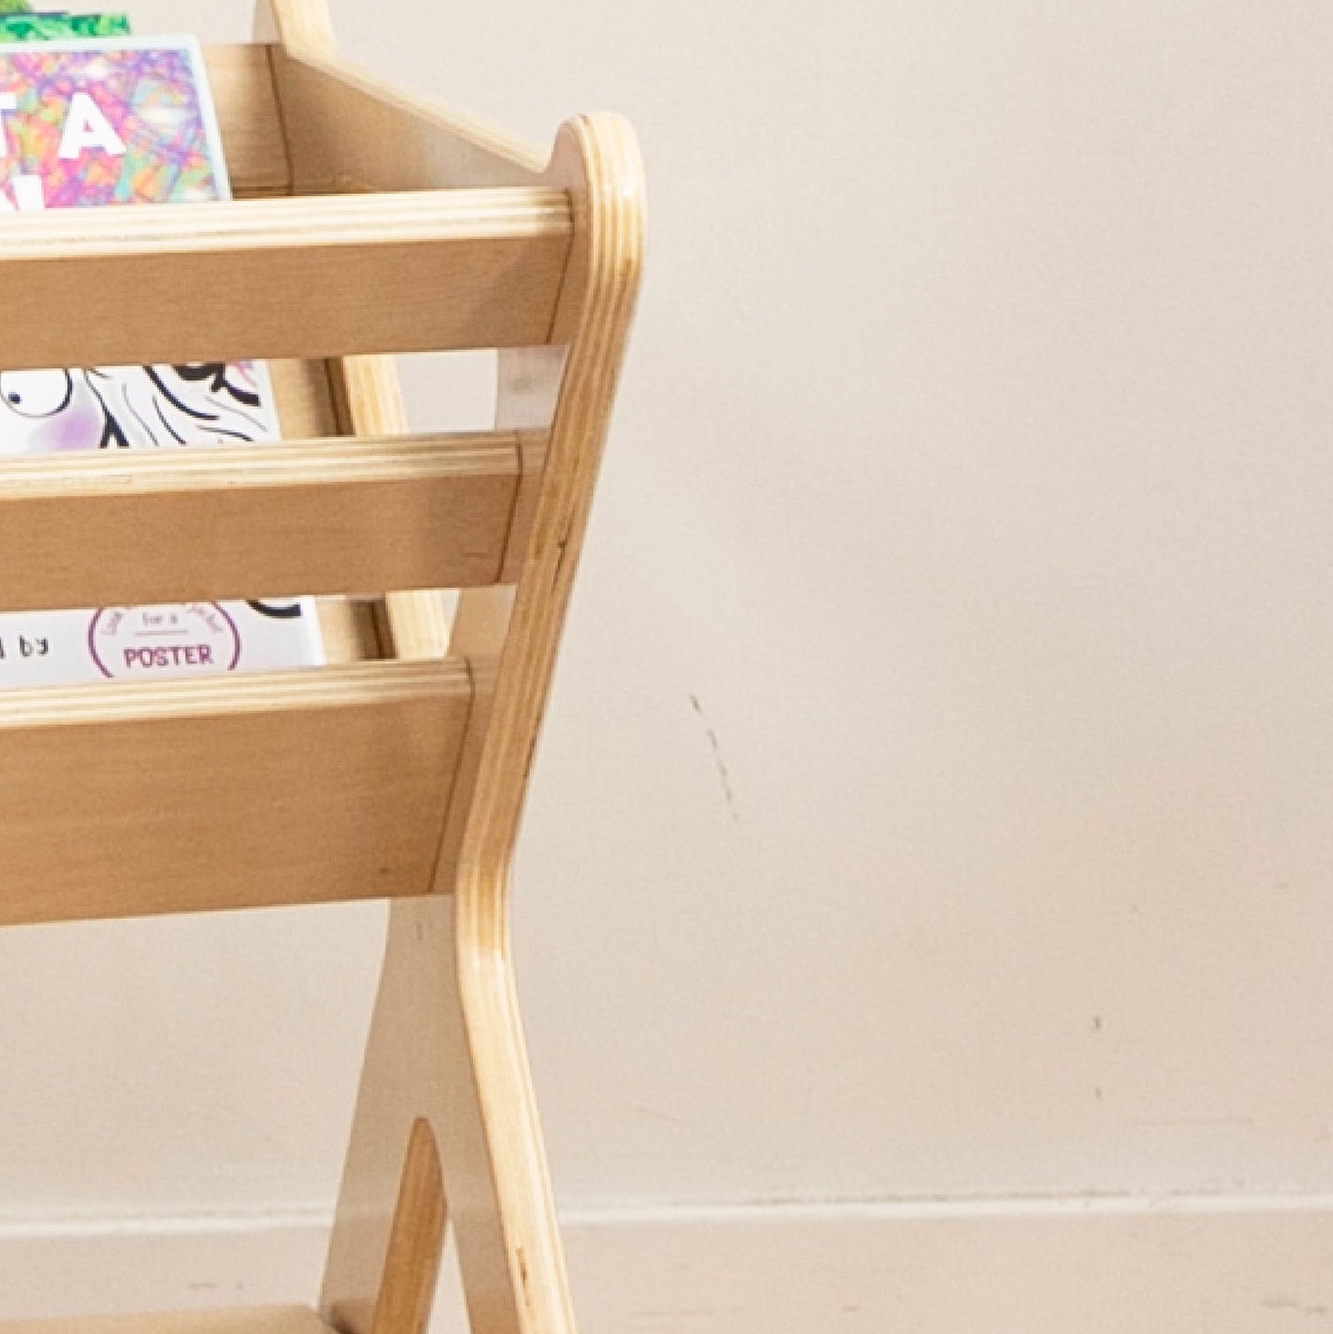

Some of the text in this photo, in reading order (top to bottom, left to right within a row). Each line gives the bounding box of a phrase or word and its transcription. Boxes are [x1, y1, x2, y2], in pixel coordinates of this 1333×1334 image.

[57, 91, 127, 159] A
[19, 634, 49, 658] by
[123, 644, 214, 668] POSTER
